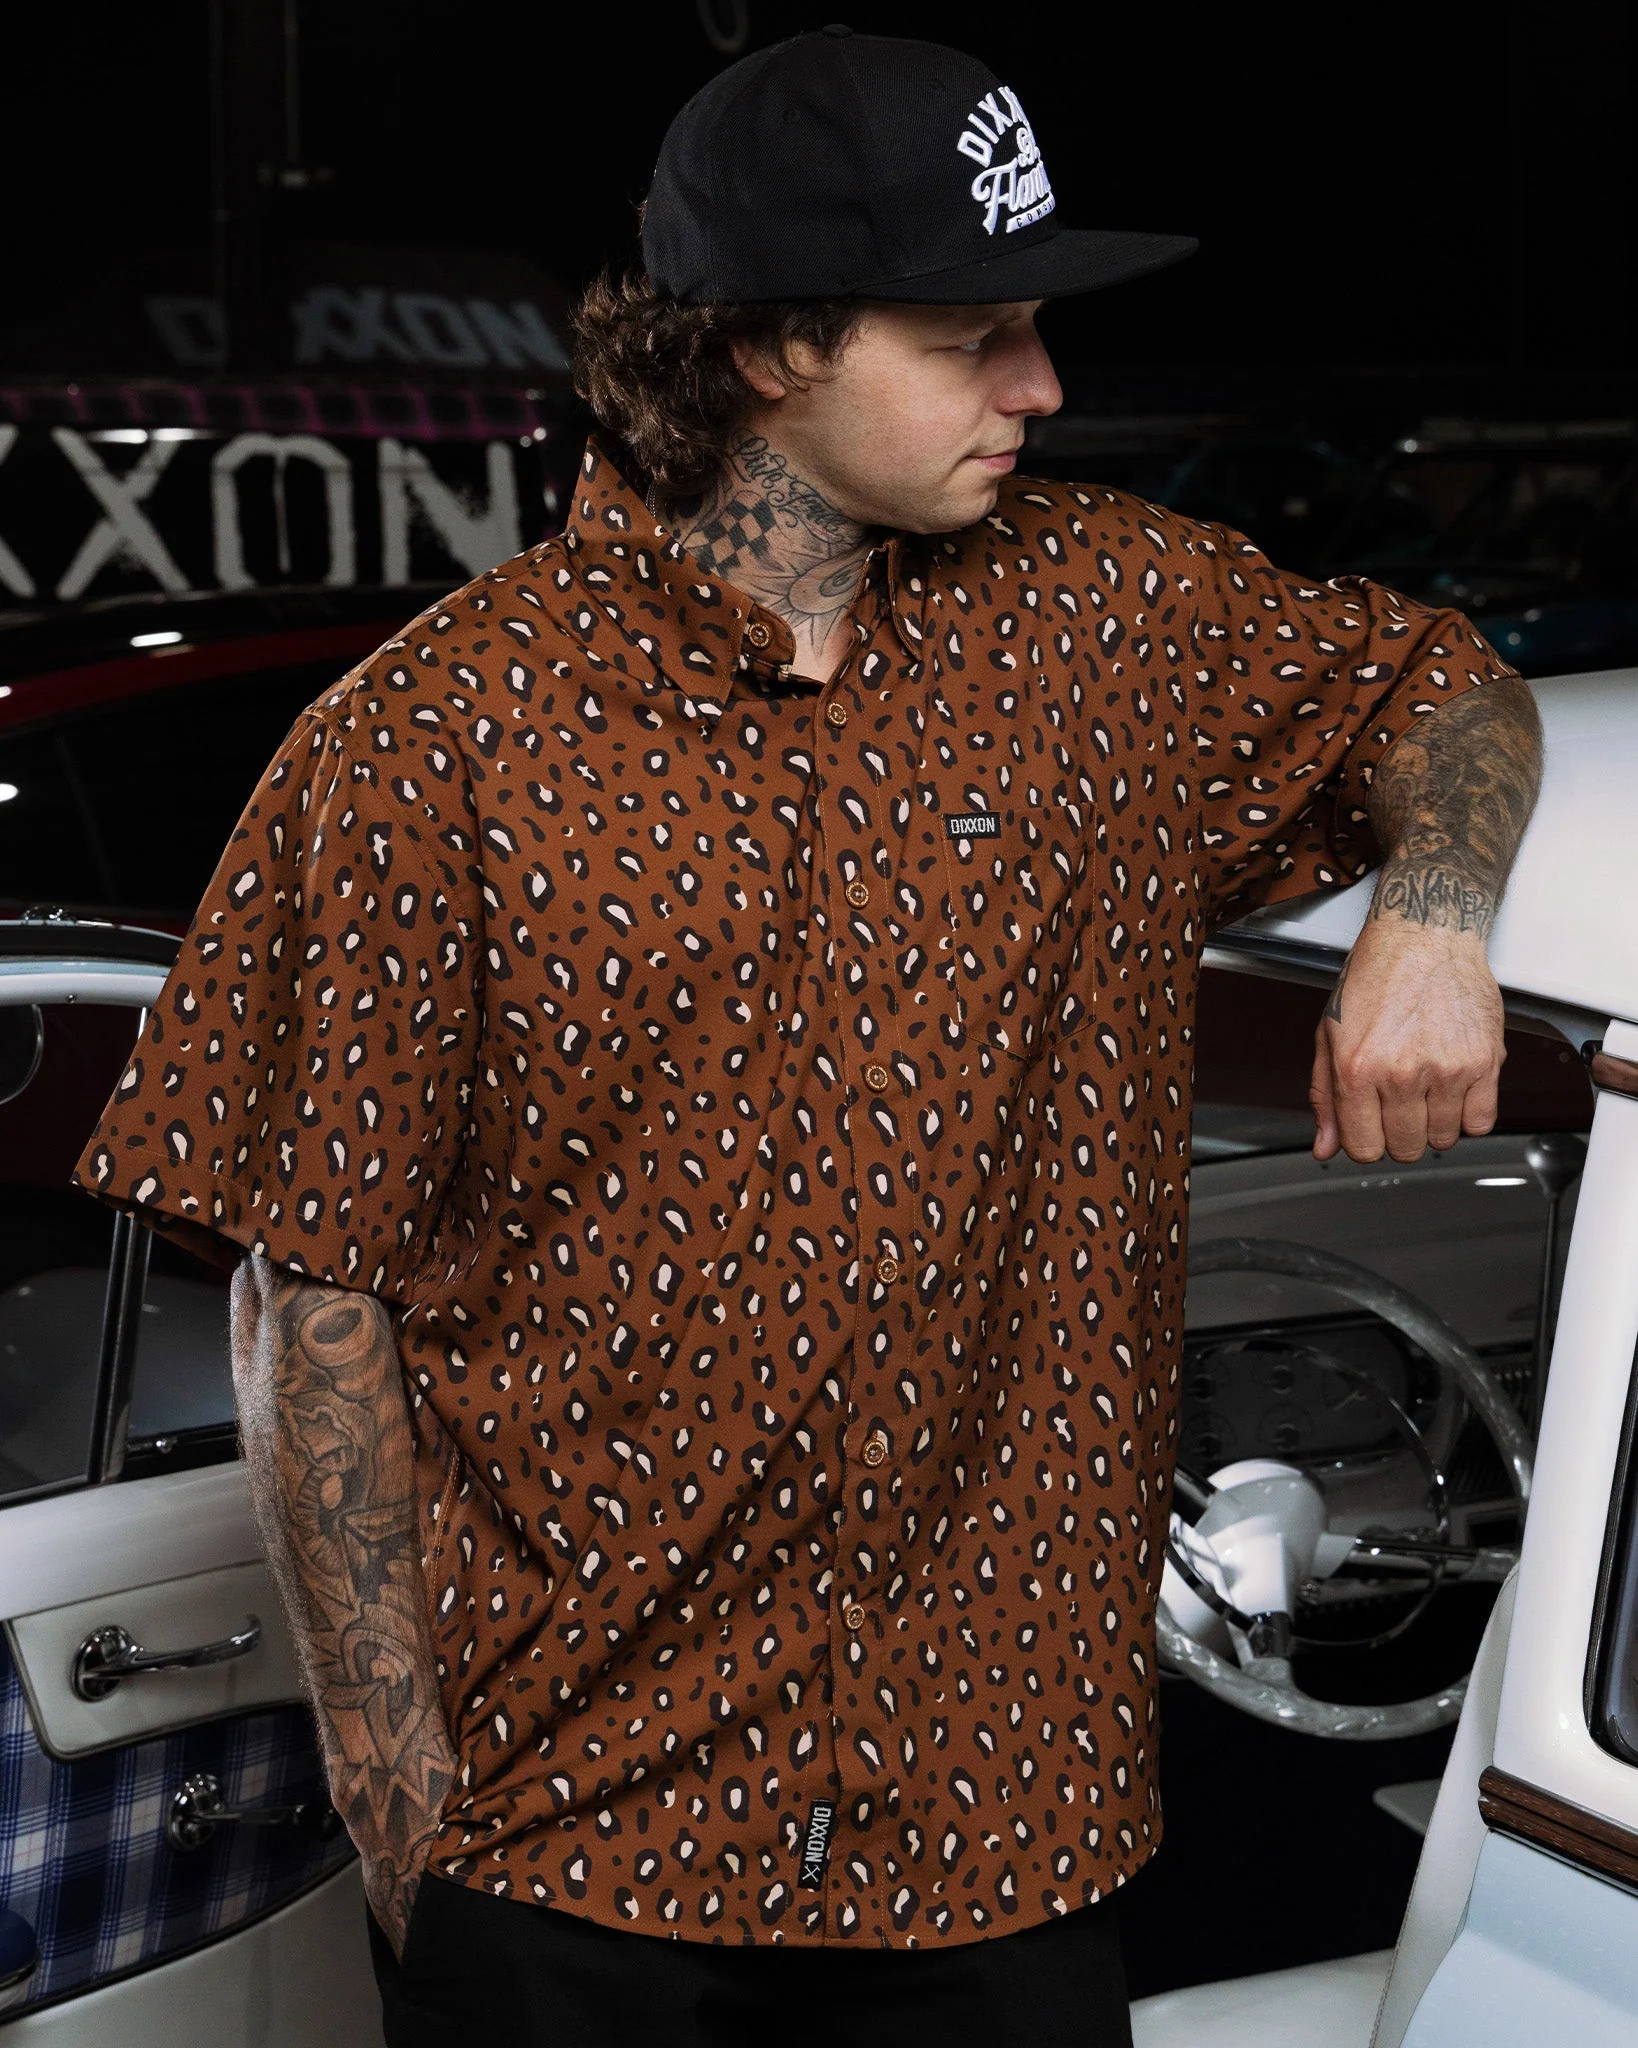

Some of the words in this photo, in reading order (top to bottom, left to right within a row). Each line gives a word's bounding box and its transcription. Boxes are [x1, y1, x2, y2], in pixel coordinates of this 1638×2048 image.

[957, 86, 1030, 168] DIXX
[144, 282, 572, 372] DXXON
[950, 817, 995, 834] DIXXON
[805, 1806, 832, 1862] DIXXON
